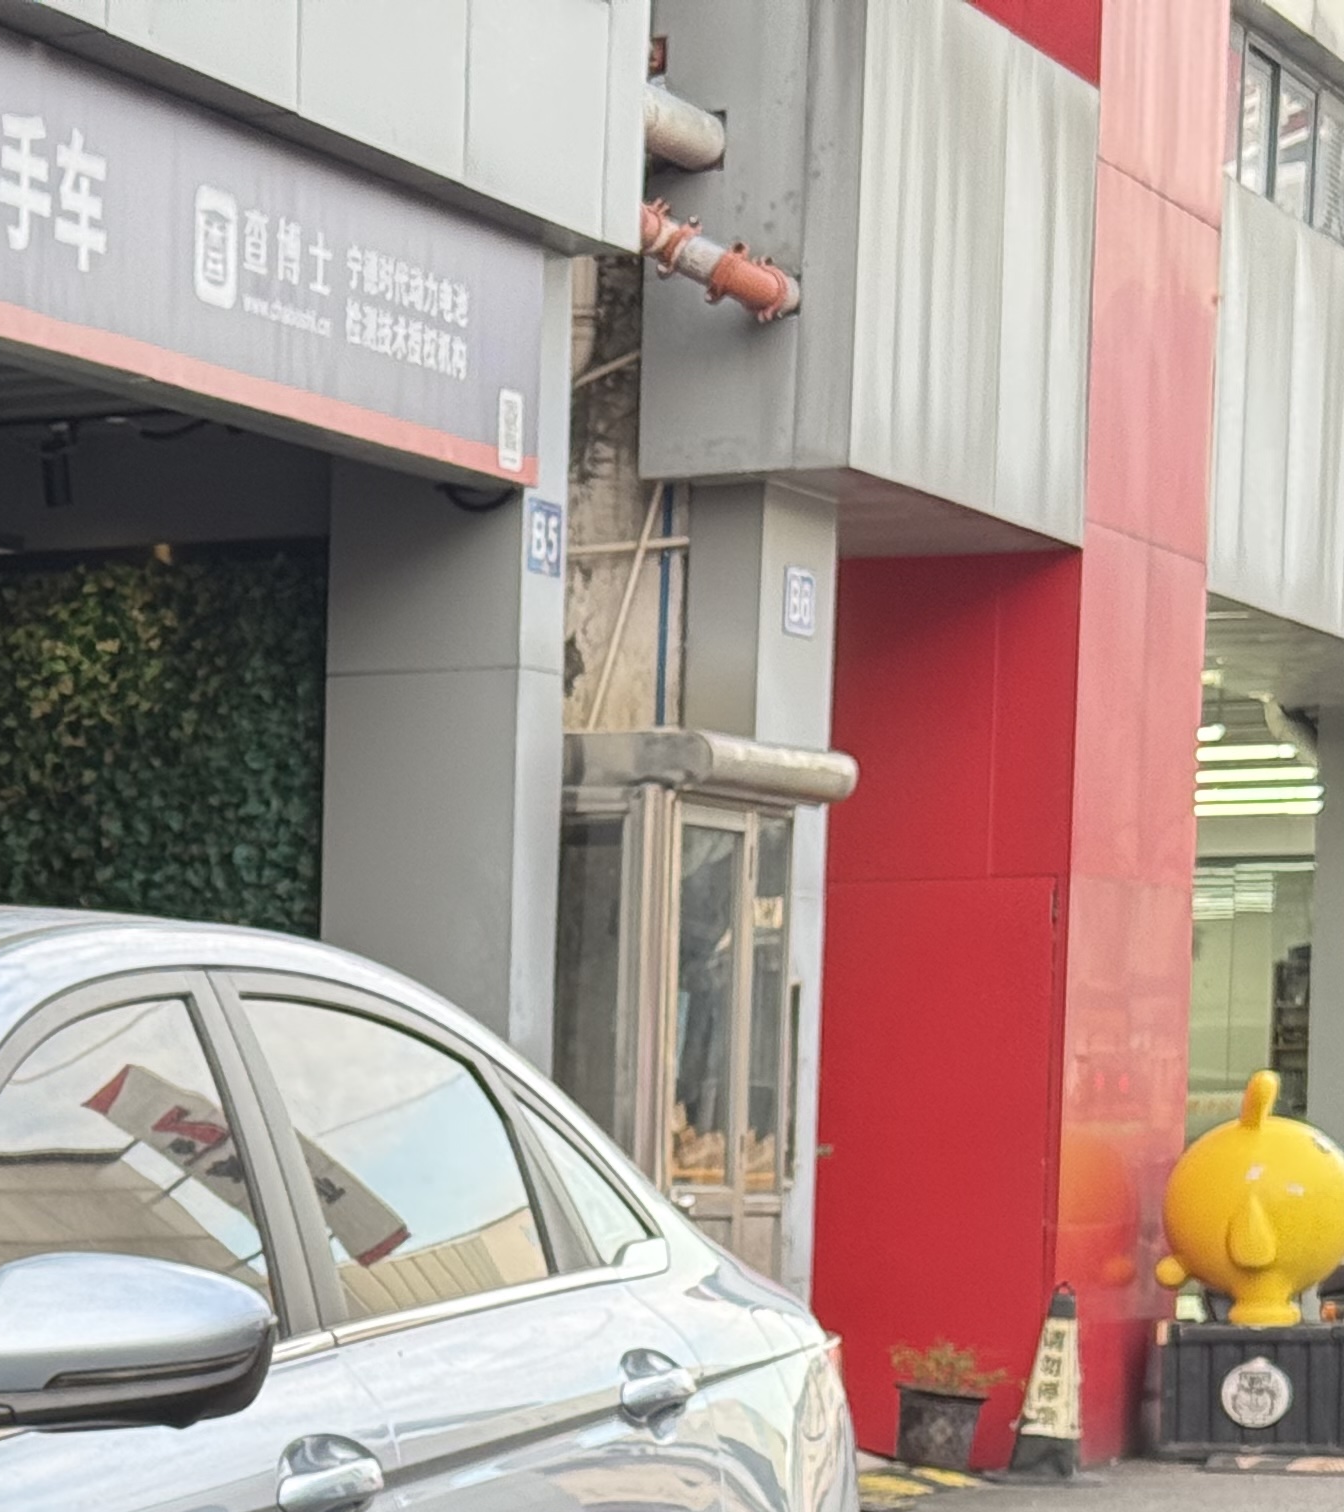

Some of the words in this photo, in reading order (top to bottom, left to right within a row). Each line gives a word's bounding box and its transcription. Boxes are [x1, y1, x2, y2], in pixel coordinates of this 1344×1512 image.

[243, 208, 333, 296] 查博士
[531, 511, 559, 565] B5
